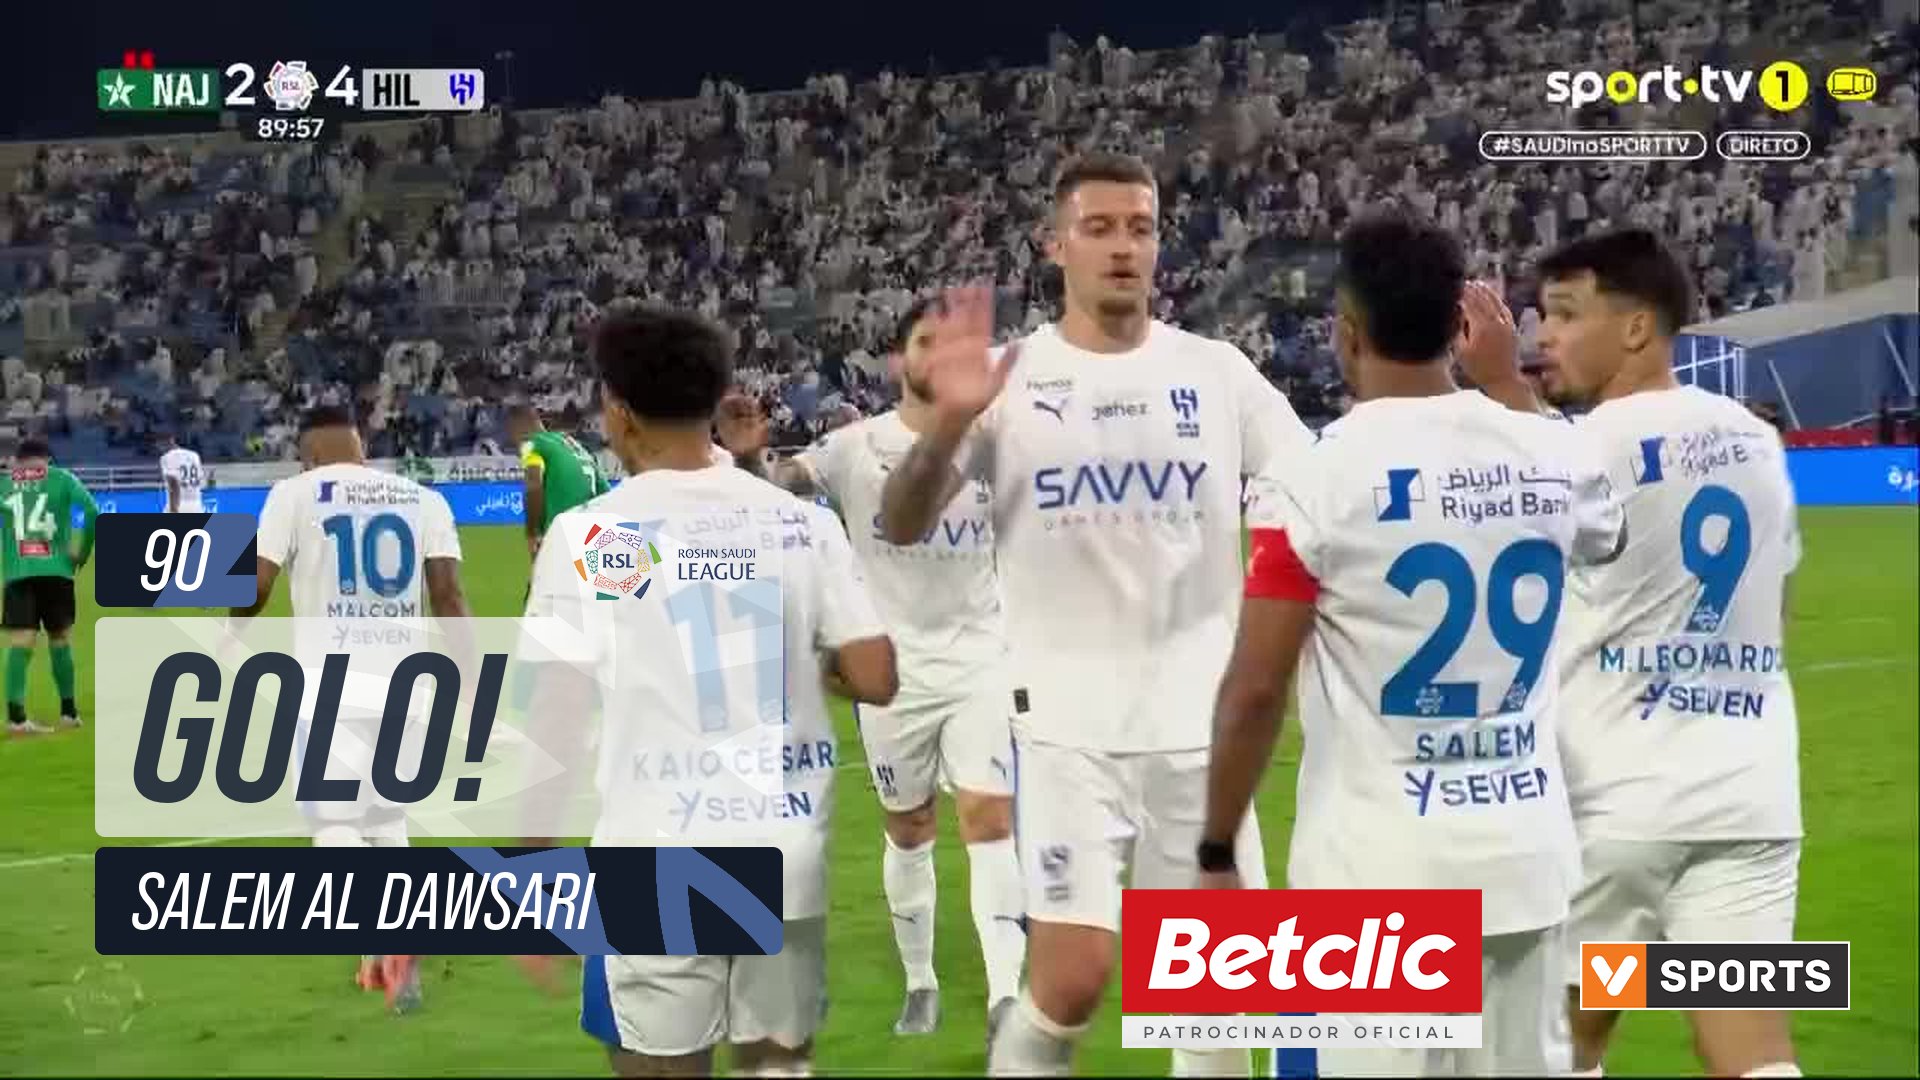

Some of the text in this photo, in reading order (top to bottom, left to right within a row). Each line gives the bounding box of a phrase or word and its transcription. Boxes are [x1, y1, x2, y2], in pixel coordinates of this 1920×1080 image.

[1034, 460, 1208, 511] SAVVY
[1441, 493, 1513, 524] Riyad
[4, 491, 57, 541] 14
[322, 512, 416, 598] 10
[1680, 484, 1752, 633] 9
[327, 602, 415, 618] MALCOM
[1380, 538, 1565, 718] 29
[632, 735, 835, 781] KAIO CÉSAR
[1415, 720, 1536, 764] SALEM
